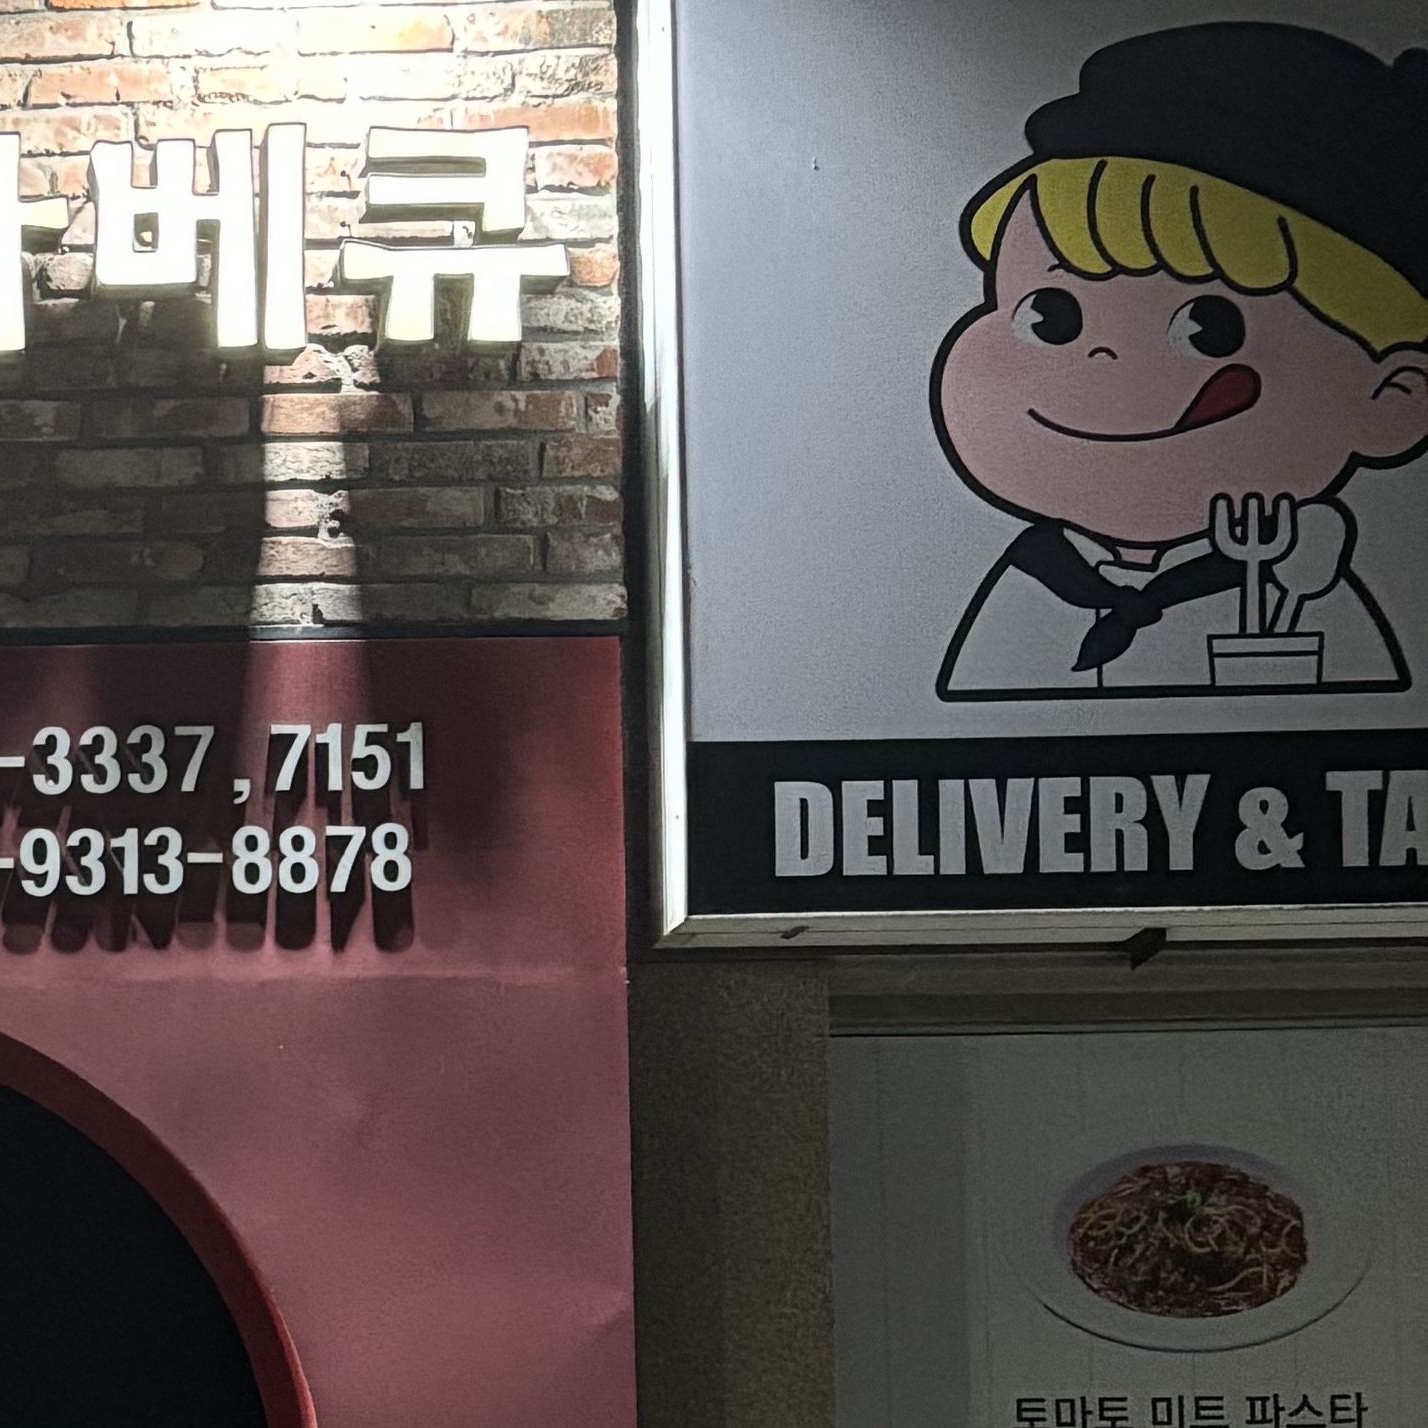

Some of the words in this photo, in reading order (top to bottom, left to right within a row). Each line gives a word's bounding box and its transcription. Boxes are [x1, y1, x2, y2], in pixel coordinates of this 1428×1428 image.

[774, 774, 1211, 877] DELIVERY
[1235, 787, 1305, 871] &
[1325, 769, 1428, 868] TA
